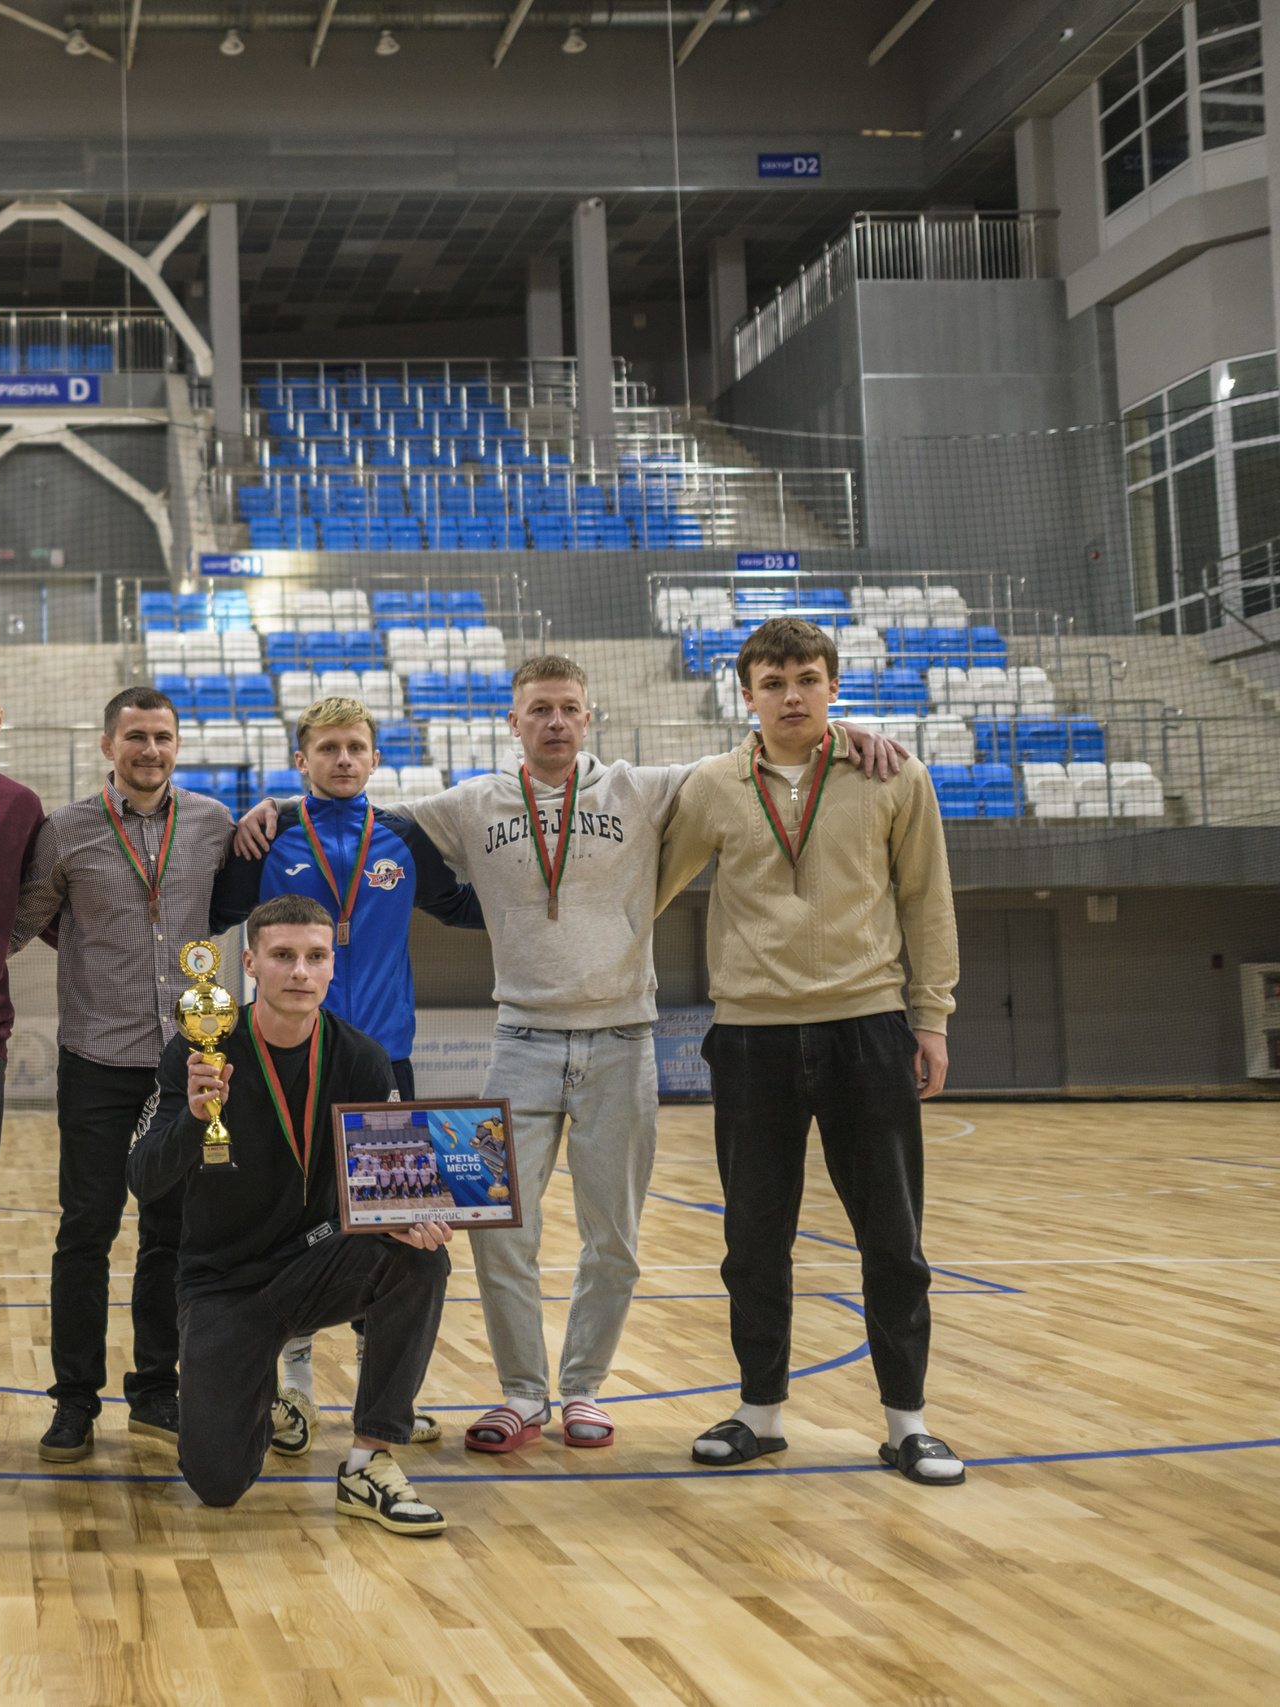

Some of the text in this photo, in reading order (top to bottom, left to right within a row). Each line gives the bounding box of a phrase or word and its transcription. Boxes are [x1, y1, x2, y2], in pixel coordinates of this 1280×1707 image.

[793, 157, 819, 174] D2
[68, 378, 91, 401] D
[229, 557, 251, 573] D4
[764, 555, 784, 570] D3
[443, 1153, 480, 1163] ТРЕТЬЕ
[446, 1163, 482, 1173] МЕСТО
